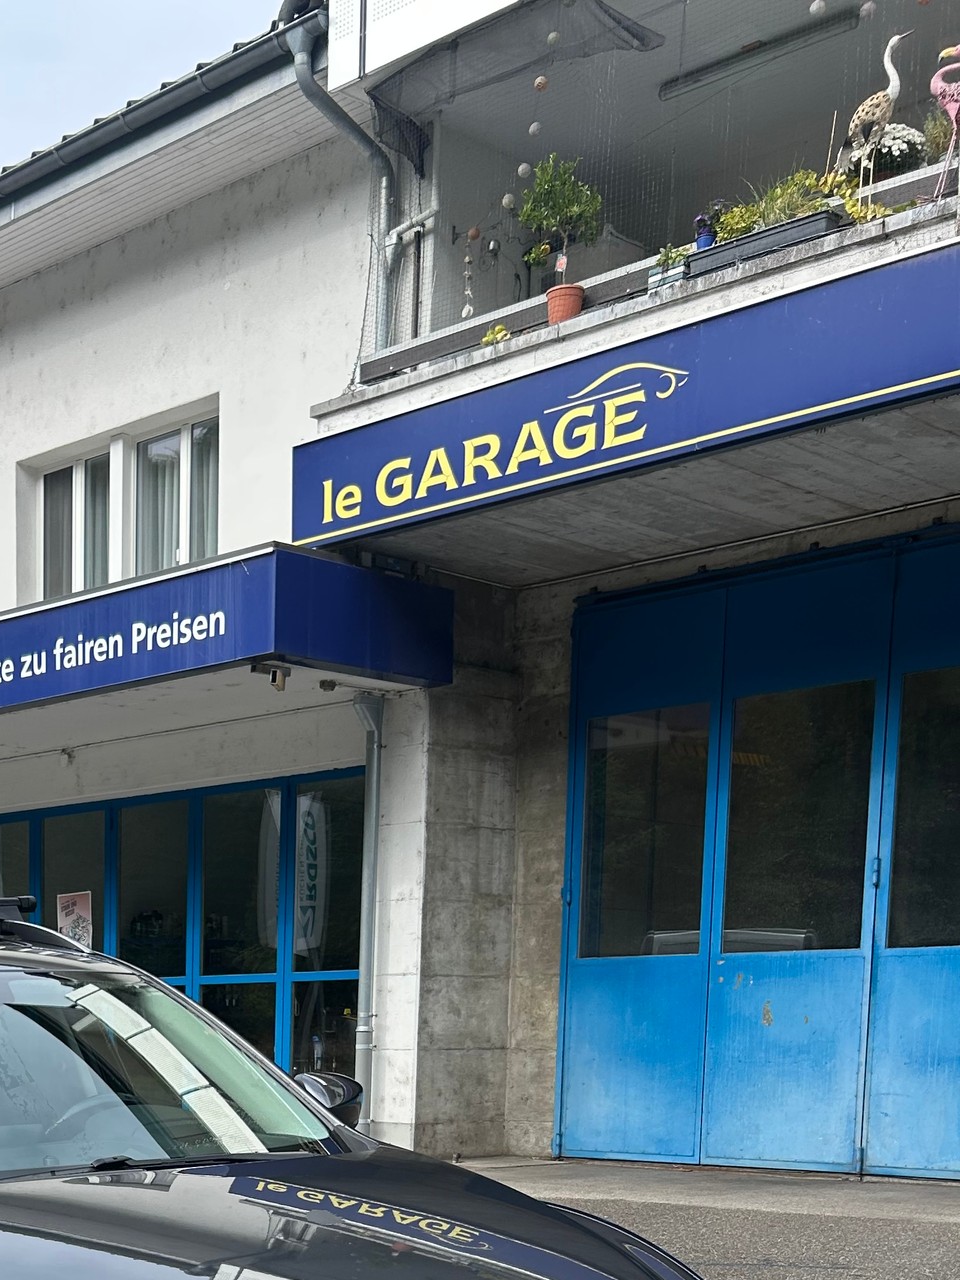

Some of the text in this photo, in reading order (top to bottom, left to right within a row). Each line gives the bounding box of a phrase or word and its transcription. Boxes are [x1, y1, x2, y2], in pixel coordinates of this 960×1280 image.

[322, 389, 648, 524] le GARAGE
[20, 650, 47, 678] zu
[53, 633, 123, 671] fairen
[131, 610, 226, 654] Preisen
